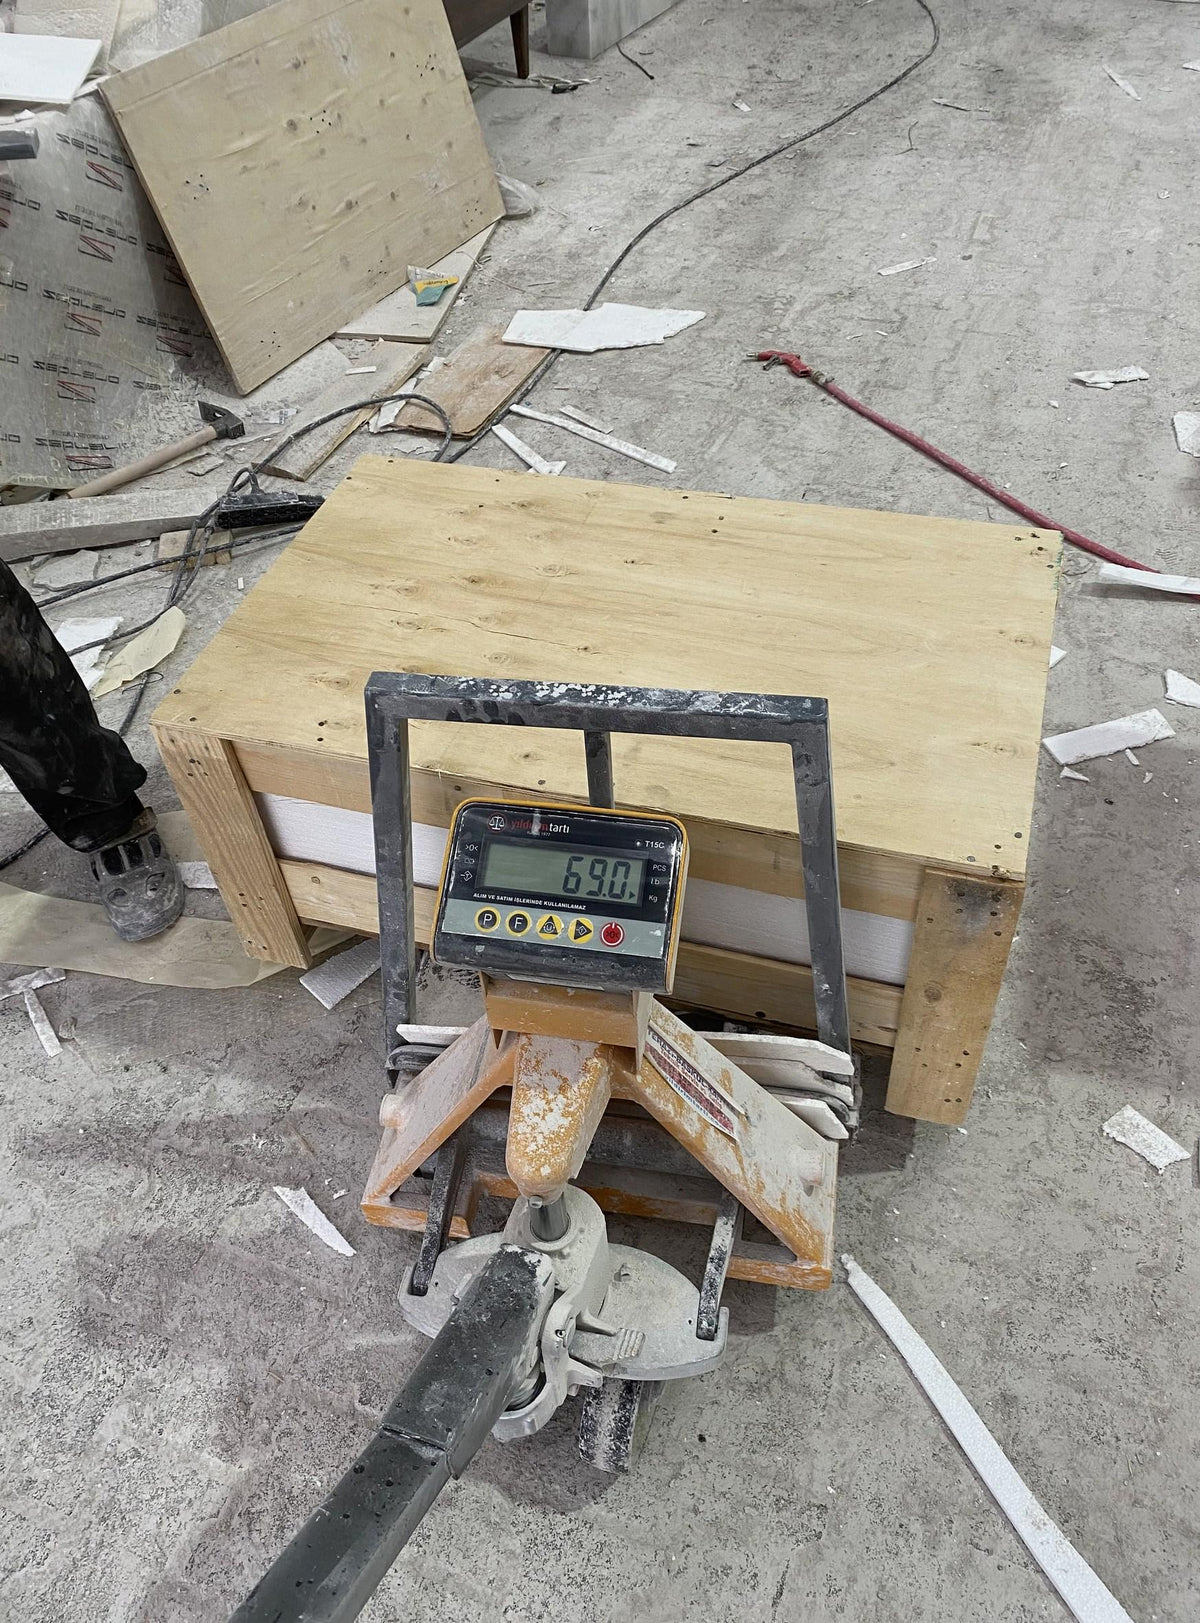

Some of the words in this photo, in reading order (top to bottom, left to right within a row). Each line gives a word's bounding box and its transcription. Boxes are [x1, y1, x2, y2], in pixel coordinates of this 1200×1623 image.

[644, 840, 665, 849] T15C
[652, 863, 667, 872] PCS
[562, 855, 631, 899] 69.0
[543, 898, 587, 911] KULLANILAMAZ
[648, 894, 658, 904] Kg
[483, 913, 493, 926] P
[514, 917, 524, 929] F
